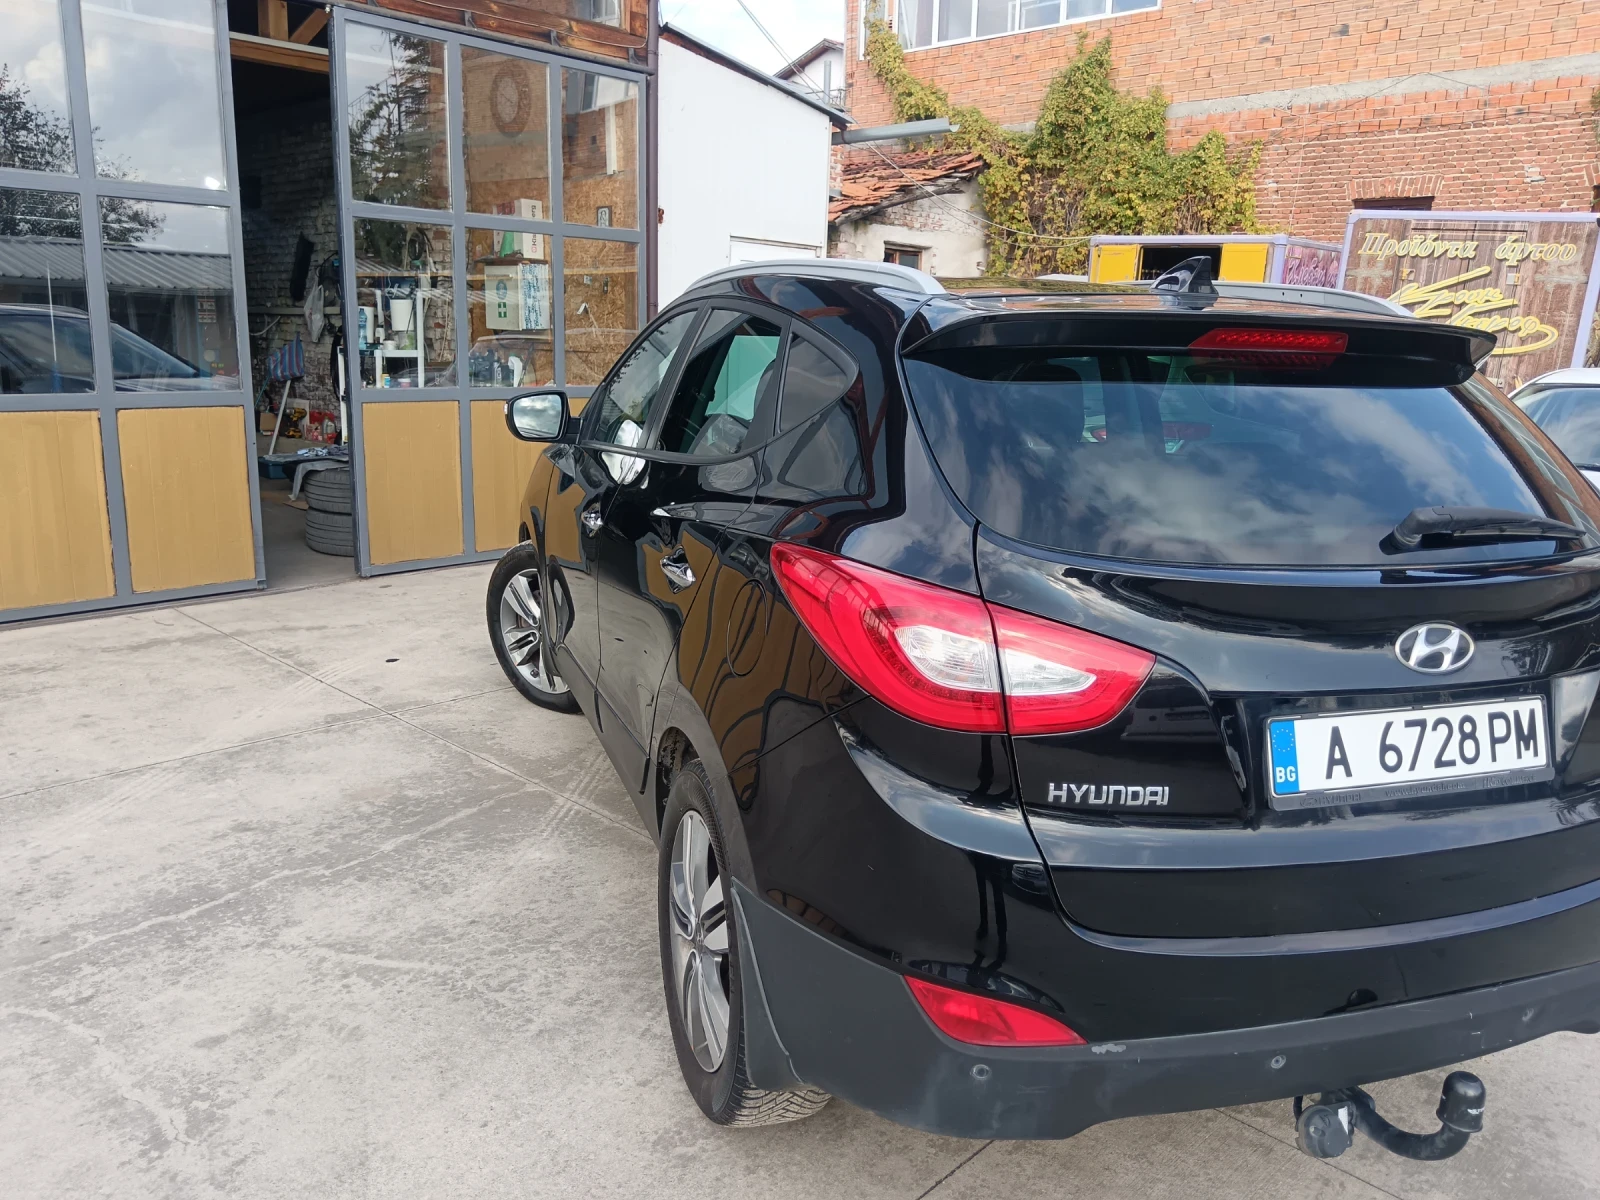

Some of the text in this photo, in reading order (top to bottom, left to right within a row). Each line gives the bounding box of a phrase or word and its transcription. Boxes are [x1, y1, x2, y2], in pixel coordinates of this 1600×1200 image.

[1358, 232, 1578, 267] Προϊόντα άρτου
[1325, 725, 1353, 779] A
[1379, 714, 1480, 773] 6728
[1275, 766, 1297, 783] BG
[1047, 782, 1170, 806] HYUNDAI
